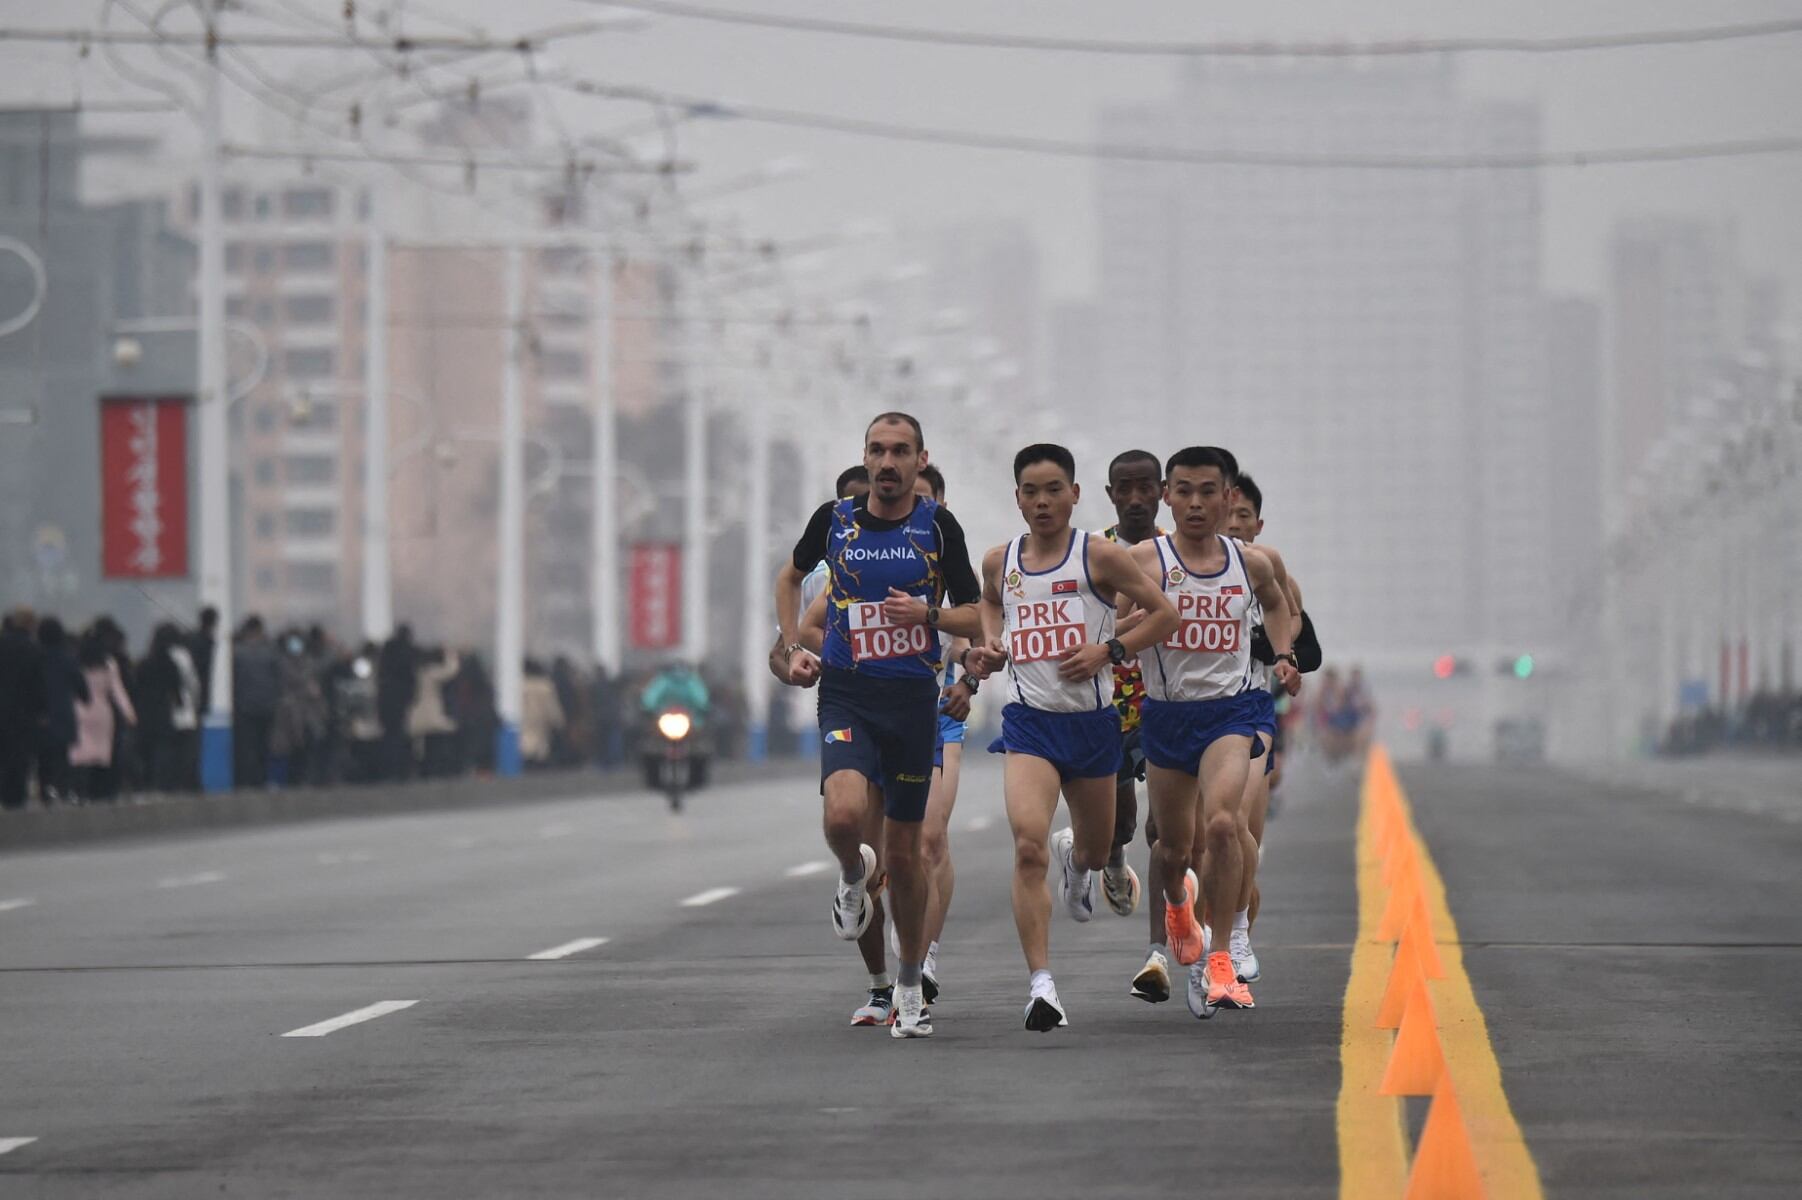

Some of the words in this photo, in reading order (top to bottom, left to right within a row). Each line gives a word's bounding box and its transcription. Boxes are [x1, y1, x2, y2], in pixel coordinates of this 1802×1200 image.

[845, 547, 917, 561] ROMANIA
[1017, 600, 1071, 628] PRK
[1178, 595, 1232, 618] PRK
[855, 624, 927, 658] 1080
[1014, 627, 1081, 660] 1010
[1167, 622, 1236, 650] 1009
